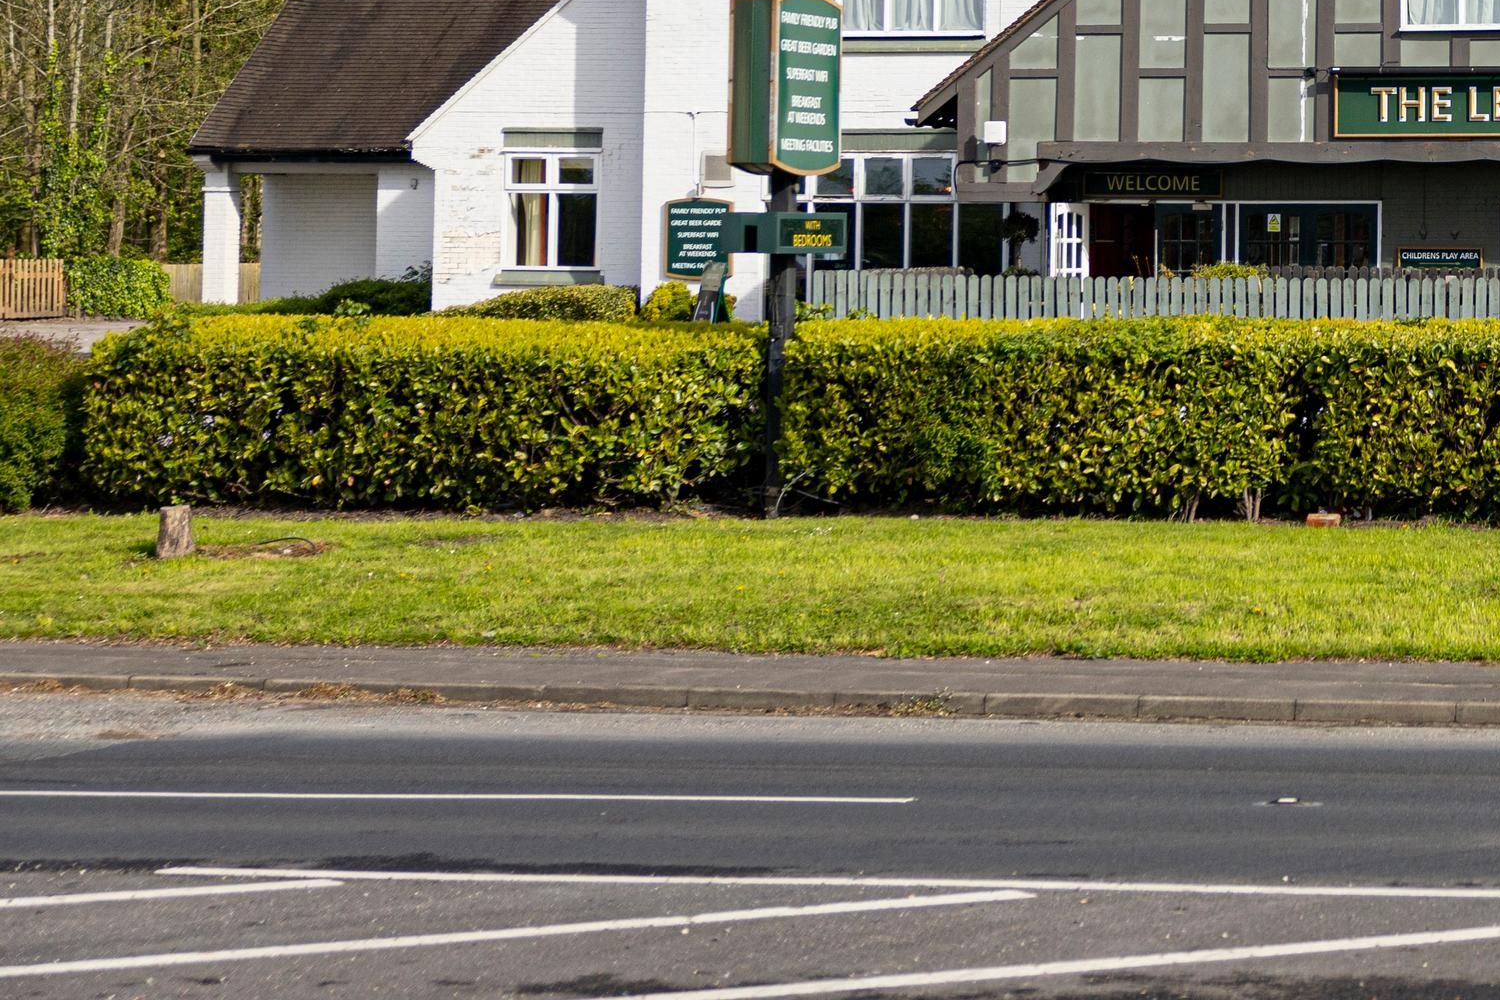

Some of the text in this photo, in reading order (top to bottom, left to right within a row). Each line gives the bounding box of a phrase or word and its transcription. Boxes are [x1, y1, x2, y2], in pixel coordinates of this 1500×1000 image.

[781, 11, 838, 30] FAMILY FRIENDLY PUB
[781, 39, 837, 57] GREAT BEER GARDEN
[786, 67, 815, 82] SUPERFAST
[791, 95, 822, 109] BREAKFAST
[1371, 86, 1452, 122] THE
[787, 111, 826, 125] AT WEEKENDS
[781, 138, 806, 151] MEETING
[1106, 175, 1200, 191] WELCOME
[805, 220, 821, 230] WITH
[793, 234, 832, 248] BEDROOMS
